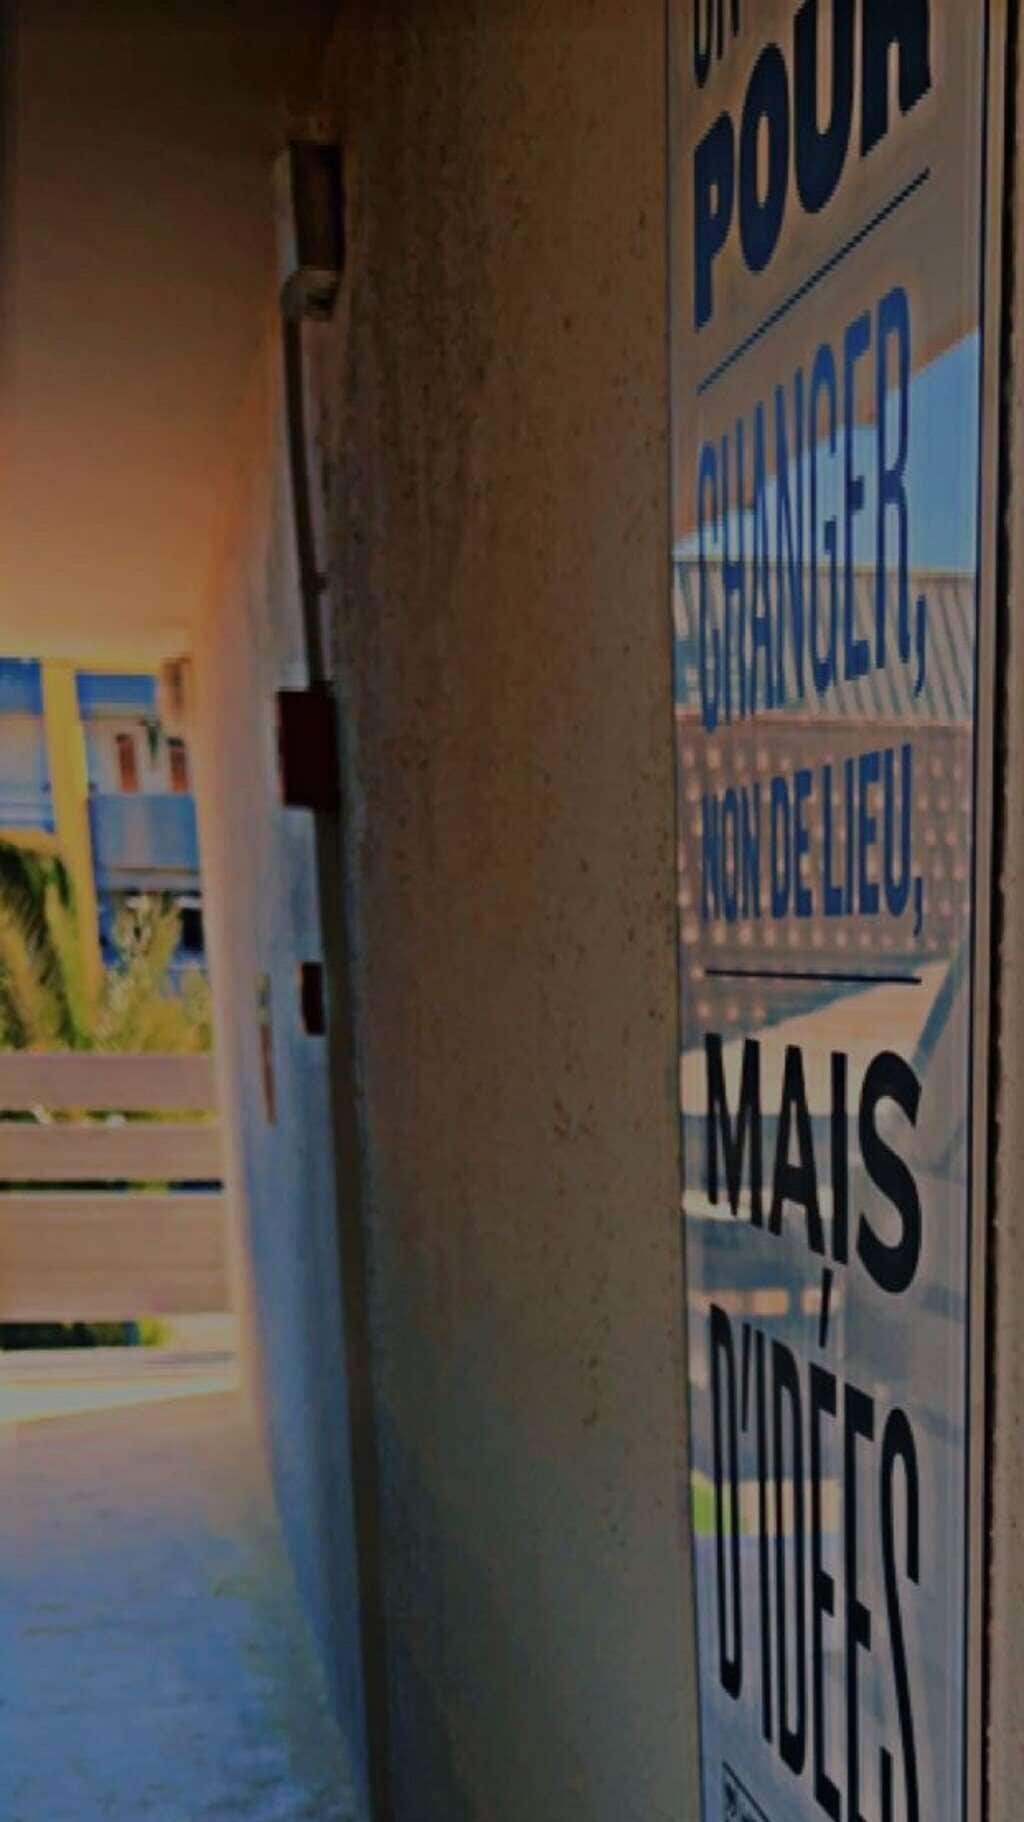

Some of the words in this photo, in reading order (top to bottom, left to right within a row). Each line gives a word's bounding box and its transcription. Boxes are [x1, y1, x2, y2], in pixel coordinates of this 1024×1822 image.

[694, 0, 931, 333] POUR
[698, 287, 926, 733] CHANGER,
[702, 782, 760, 924] NON
[771, 769, 812, 919] DE
[823, 743, 923, 937] LIEU,
[705, 1033, 922, 1293] MAIS
